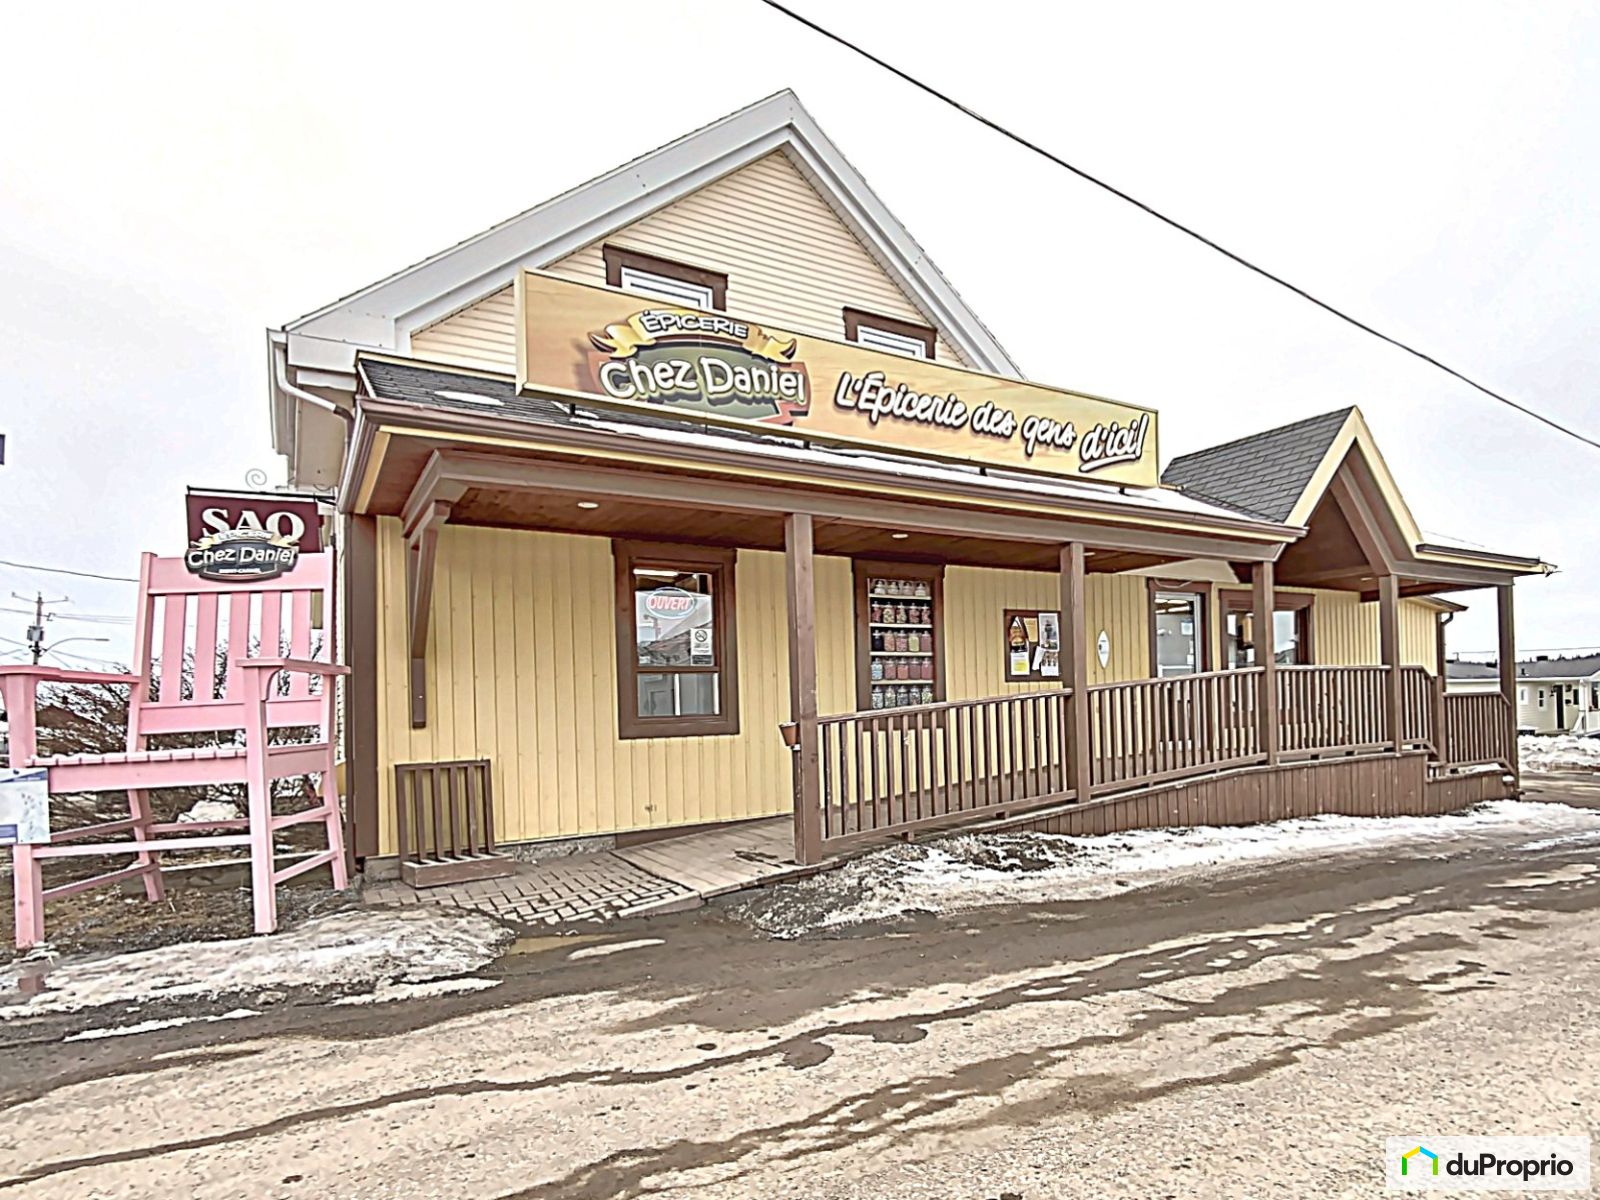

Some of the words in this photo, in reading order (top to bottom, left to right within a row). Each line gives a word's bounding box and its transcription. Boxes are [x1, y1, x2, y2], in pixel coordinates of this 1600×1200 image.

[640, 310, 749, 339] ÉPICERIE
[599, 357, 698, 399] Chez
[699, 356, 806, 403] Daniel
[835, 371, 969, 425] L'Épicerie
[971, 400, 1017, 439] des
[1022, 414, 1077, 456] gens
[1080, 413, 1149, 462] d'ici!
[202, 508, 305, 544] SAQ
[188, 548, 235, 566] Chez
[240, 547, 295, 566] Daniel
[650, 595, 688, 610] OUVERT
